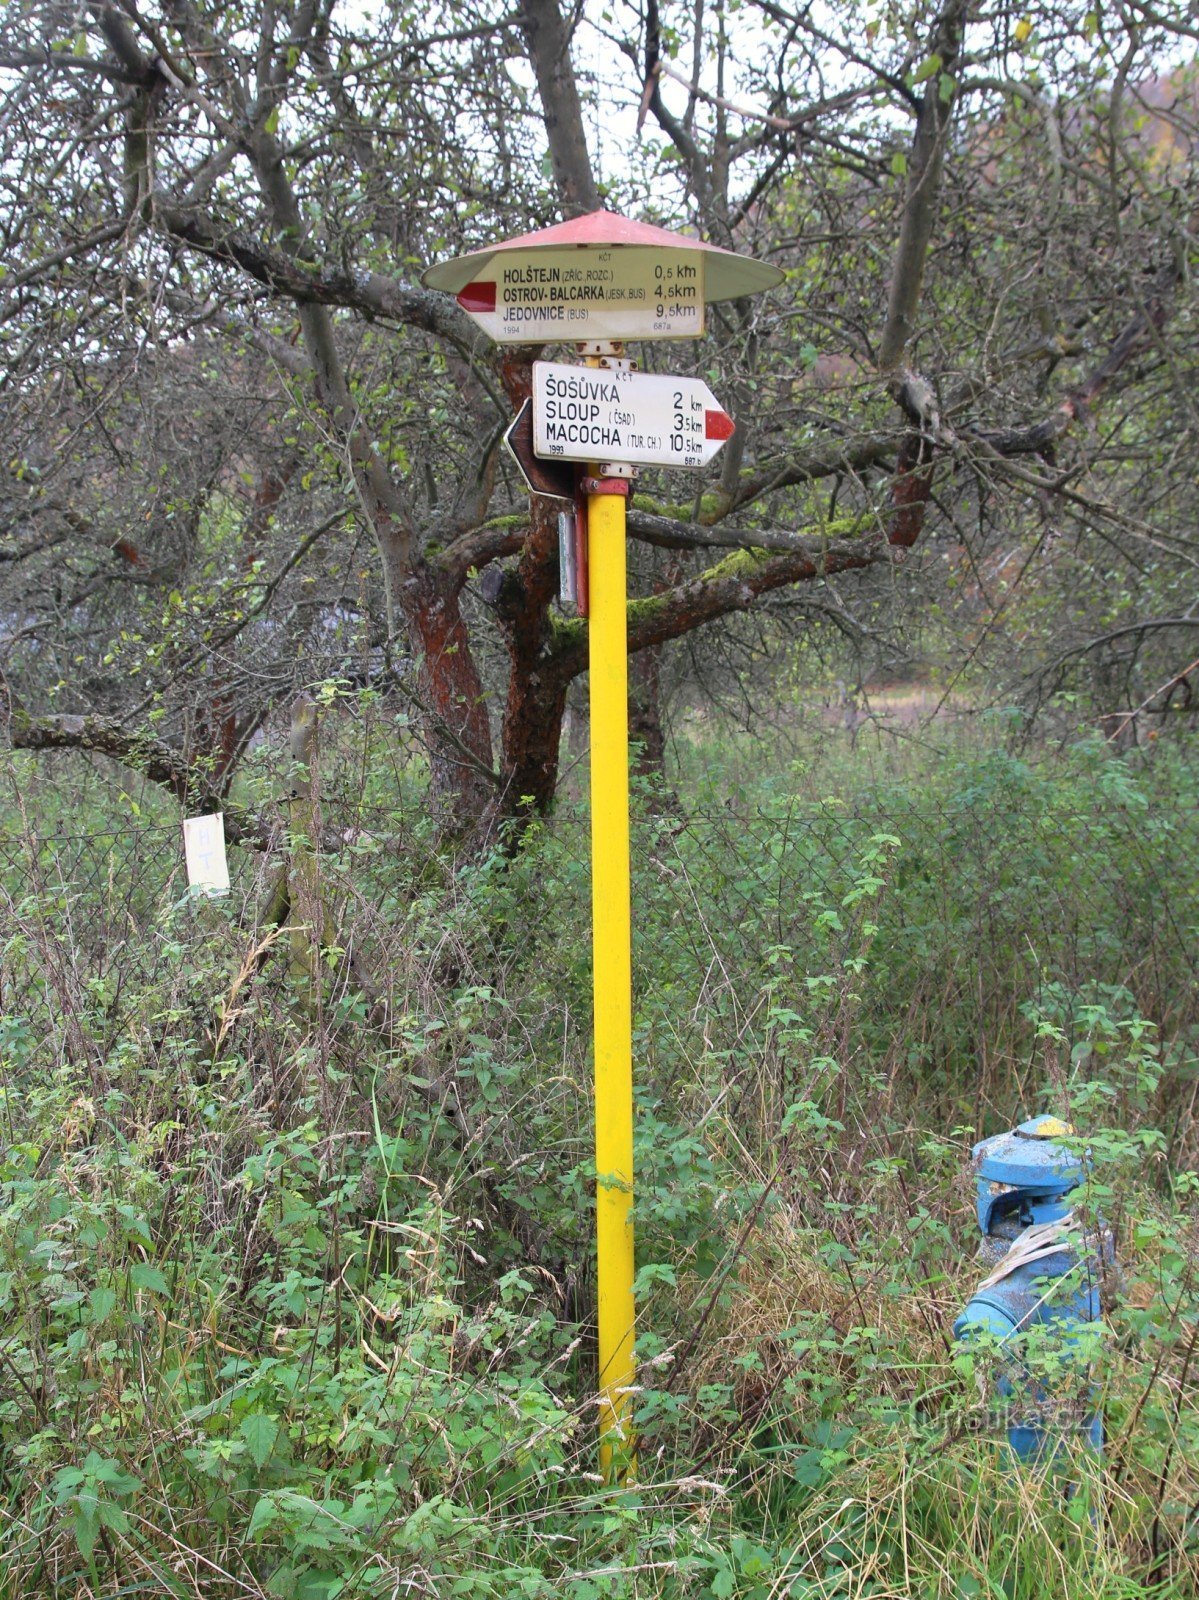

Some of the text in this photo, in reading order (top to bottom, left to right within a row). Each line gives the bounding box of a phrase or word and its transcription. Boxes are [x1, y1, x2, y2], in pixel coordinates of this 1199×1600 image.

[598, 252, 612, 262] KČT
[503, 264, 560, 284] HOLŠTEJN
[676, 264, 697, 279] km
[549, 285, 605, 301] BALCARKA
[503, 305, 565, 322] JEDOVNICE
[567, 308, 589, 321] (BUS)
[503, 326, 520, 335] 1994
[545, 373, 703, 412] ŠOŠŮVKA 2 km
[545, 400, 601, 423] SLOUP
[546, 422, 622, 447] MACOCHA
[548, 444, 565, 456] 1993
